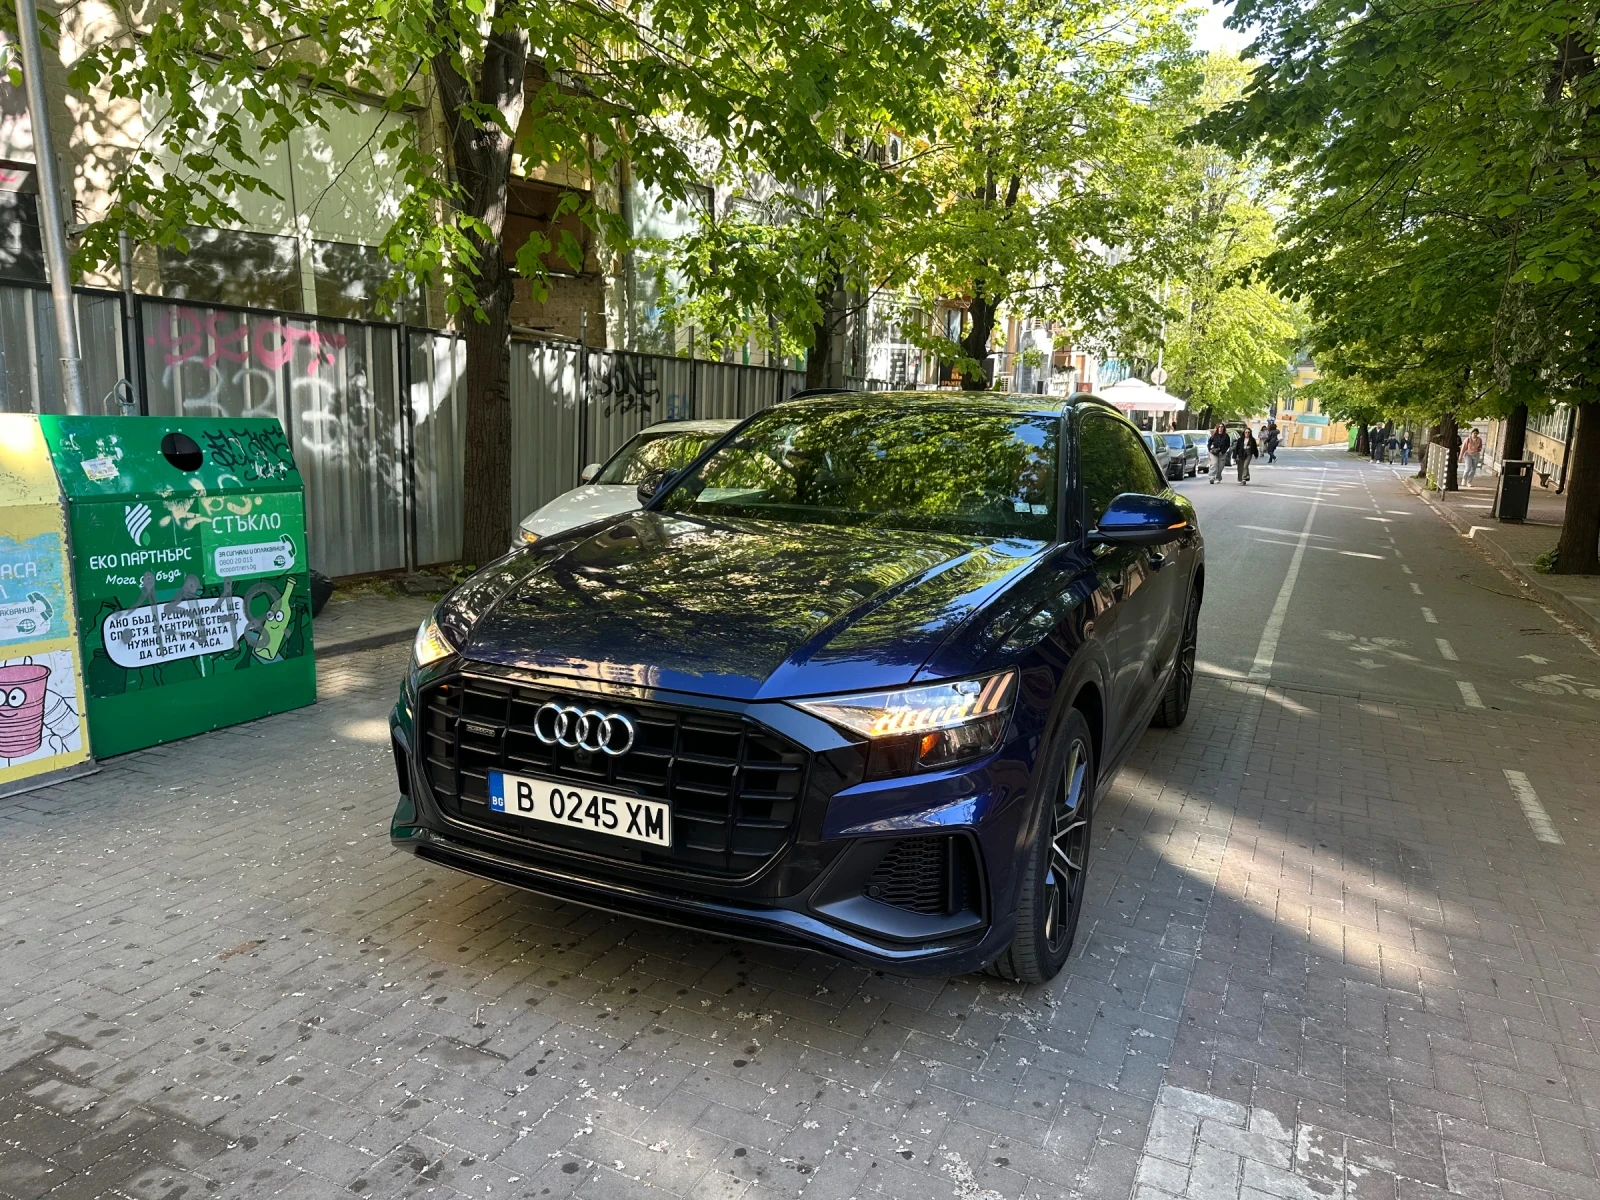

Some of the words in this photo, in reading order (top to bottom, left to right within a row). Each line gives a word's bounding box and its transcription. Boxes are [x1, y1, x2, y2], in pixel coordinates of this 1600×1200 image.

[212, 512, 281, 534] СТЪКЛО
[89, 554, 118, 570] ЕКО
[121, 547, 192, 567] ПАРТНЪРС
[105, 574, 137, 585] Мога
[155, 569, 181, 583] бъда
[109, 617, 129, 629] АКО
[110, 626, 149, 641] СПСТЯ
[127, 635, 162, 650] НУЖНО
[165, 634, 178, 644] НА
[139, 649, 153, 660] ДА
[156, 643, 186, 656] СВЕТИ
[189, 642, 195, 650] 4
[491, 795, 504, 807] BG
[516, 780, 535, 813] B
[549, 787, 619, 830] 0245
[625, 801, 664, 841] XM
